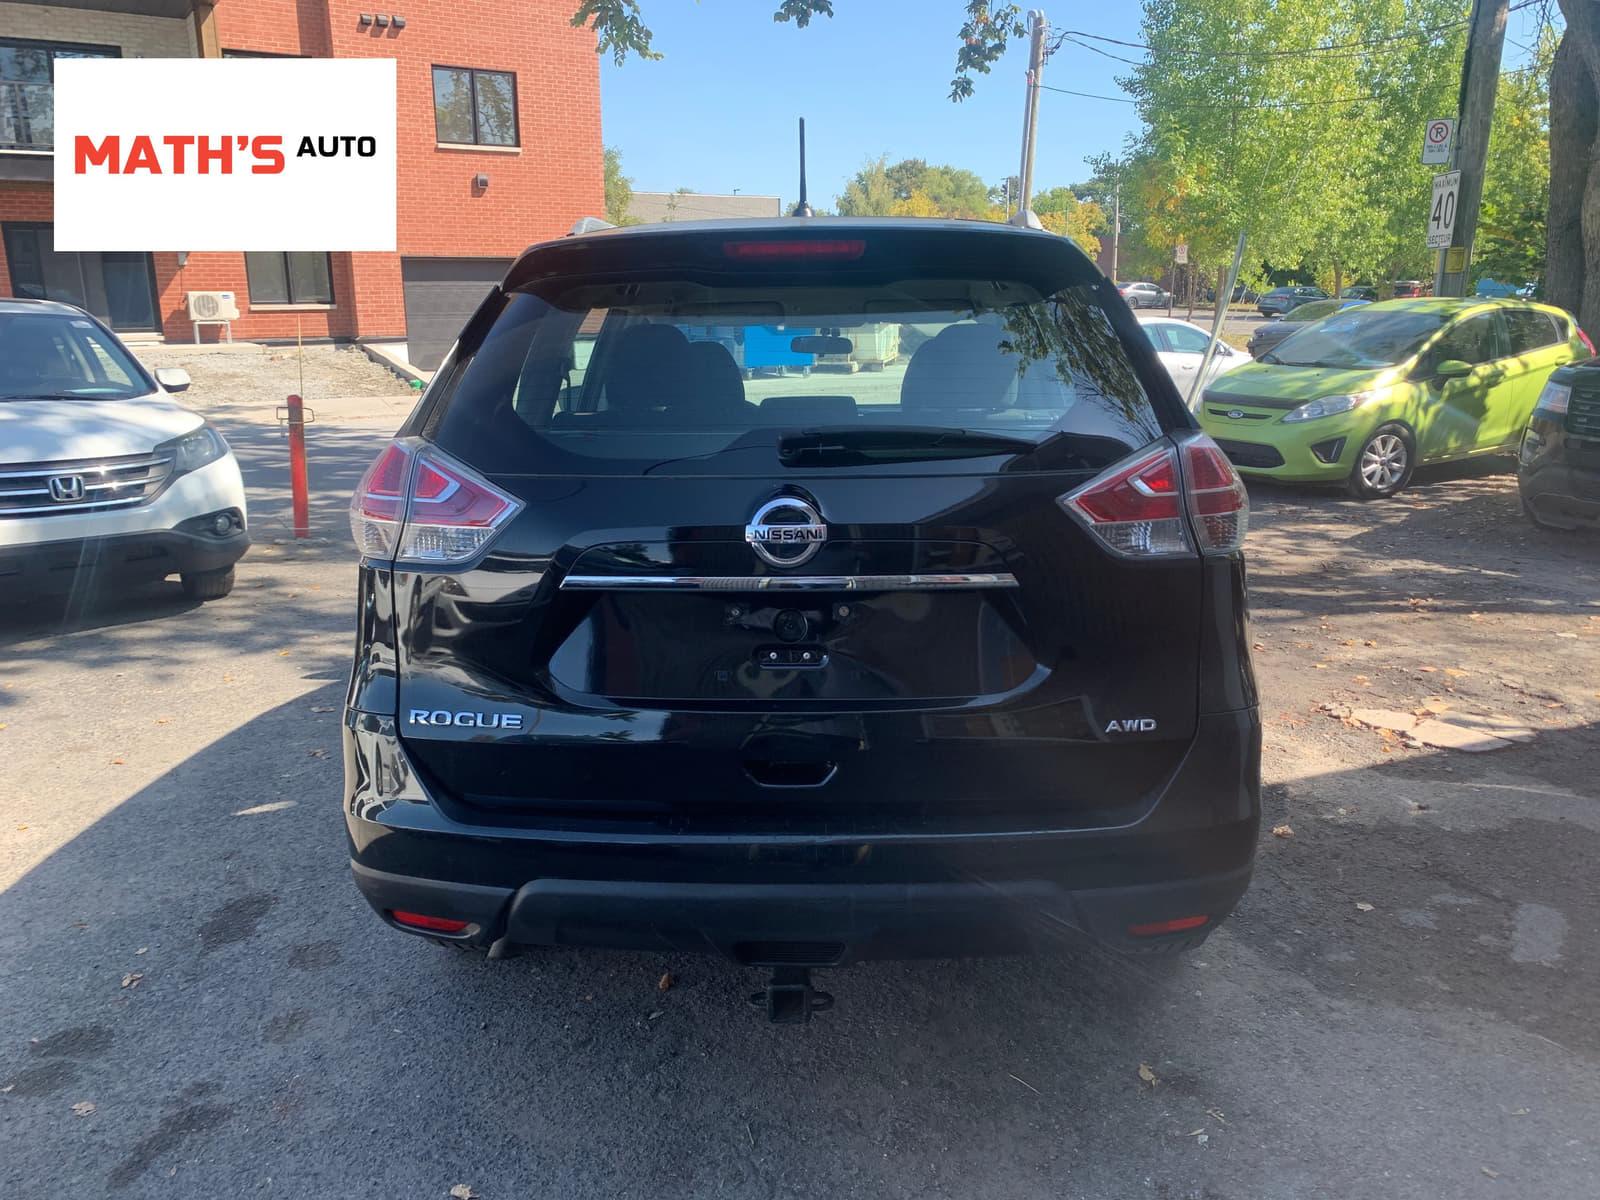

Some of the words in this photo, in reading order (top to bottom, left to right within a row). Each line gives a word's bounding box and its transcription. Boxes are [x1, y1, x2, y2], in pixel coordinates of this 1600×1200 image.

[1431, 190, 1455, 230] 40
[753, 528, 819, 541] NISSAN
[408, 708, 524, 730] ROGUE
[1104, 718, 1157, 733] AWD
